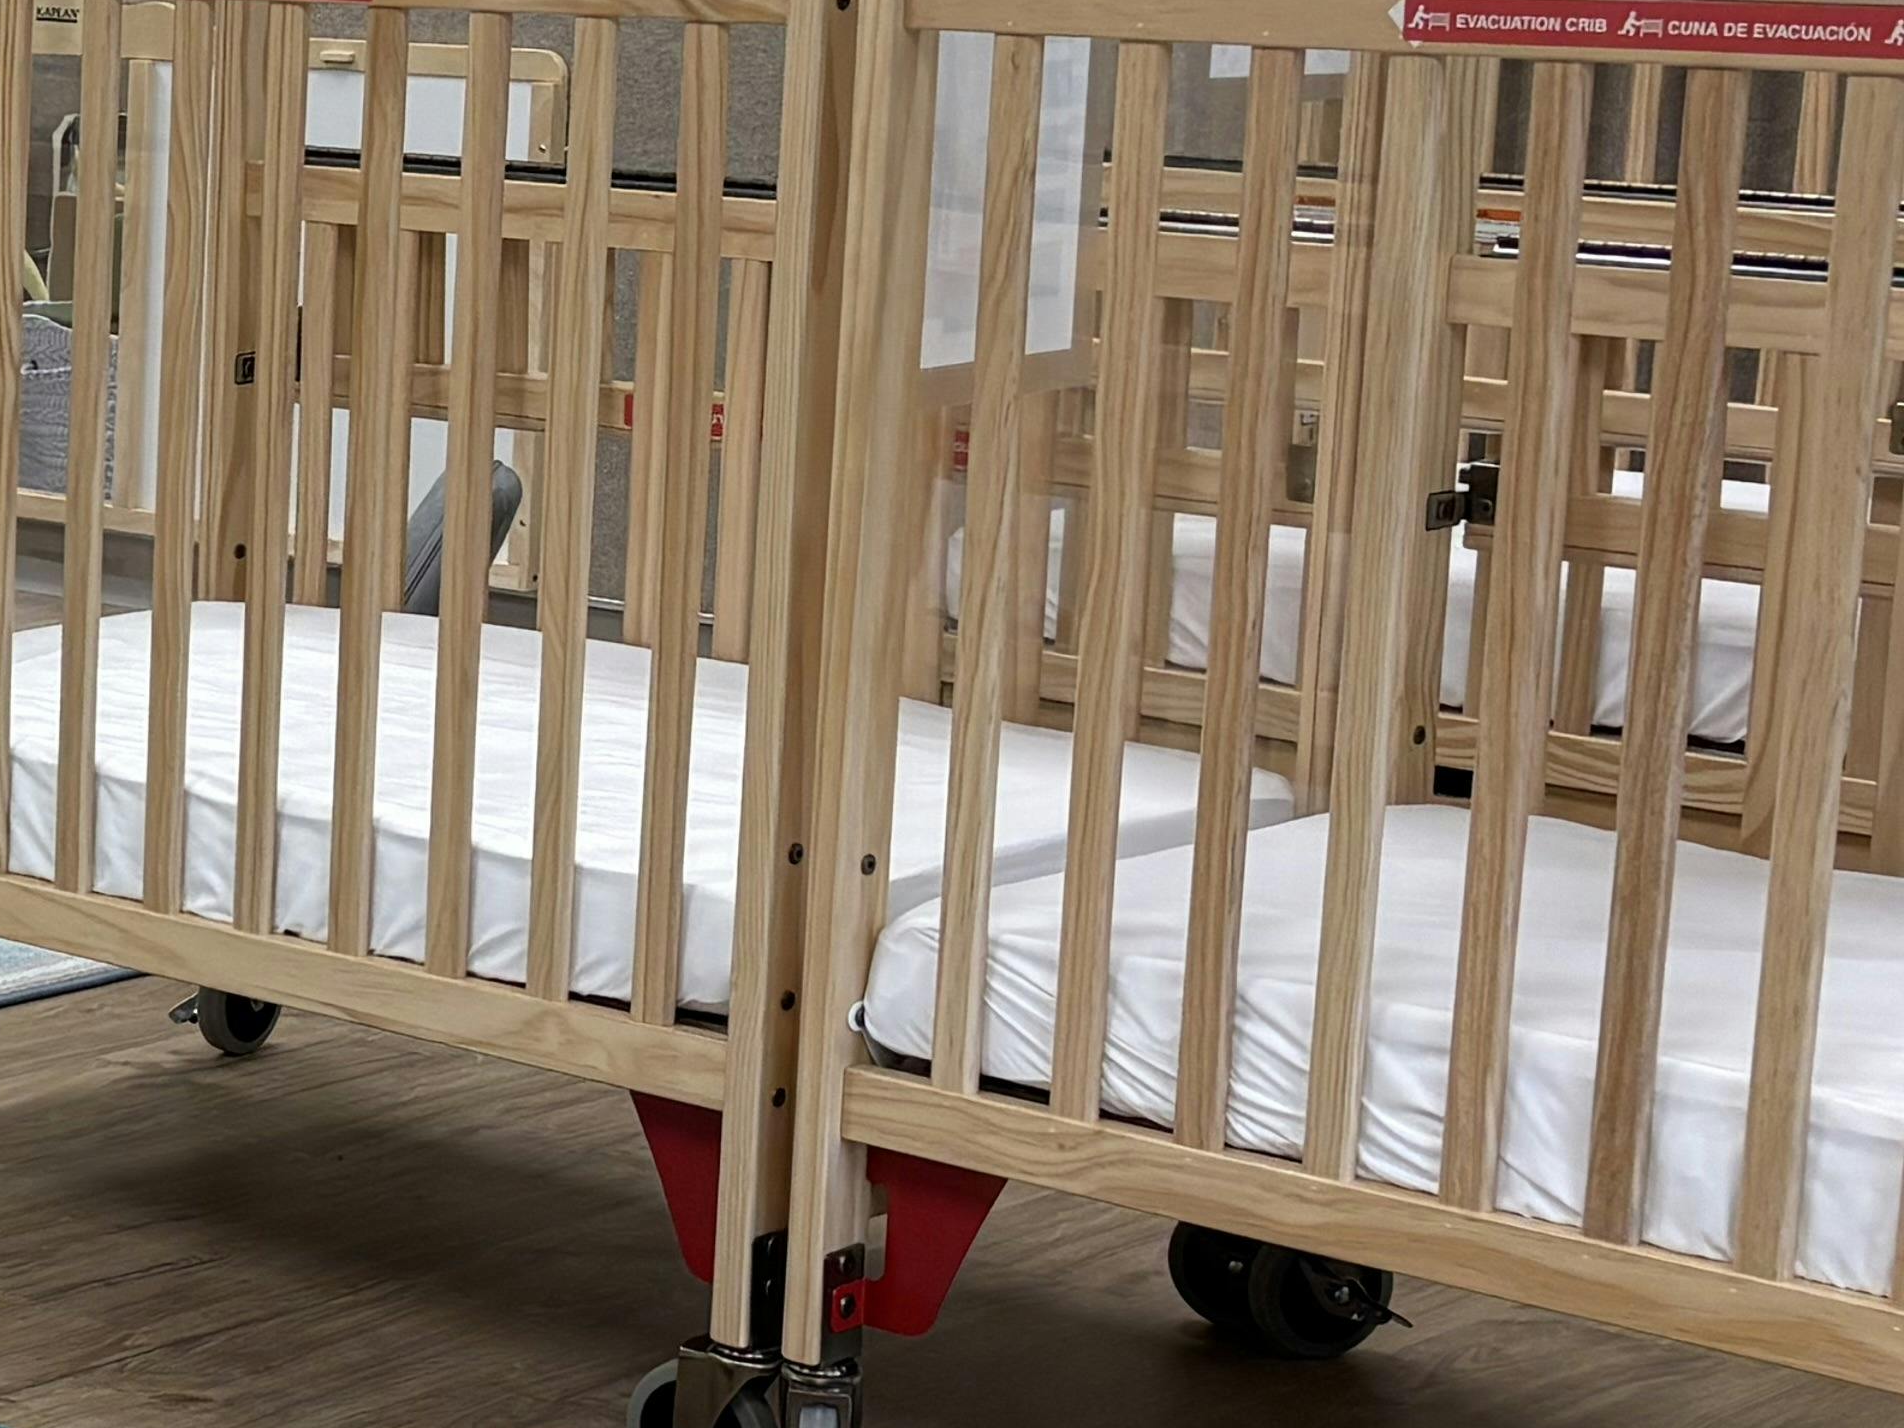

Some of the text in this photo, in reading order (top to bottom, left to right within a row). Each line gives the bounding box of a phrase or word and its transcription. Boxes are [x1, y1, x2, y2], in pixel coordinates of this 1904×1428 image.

[36, 6, 78, 18] KAPLAN
[1455, 14, 1608, 34] EVACUATION CRIB
[1667, 19, 1871, 42] CUNA DE EVACUACIÓN
